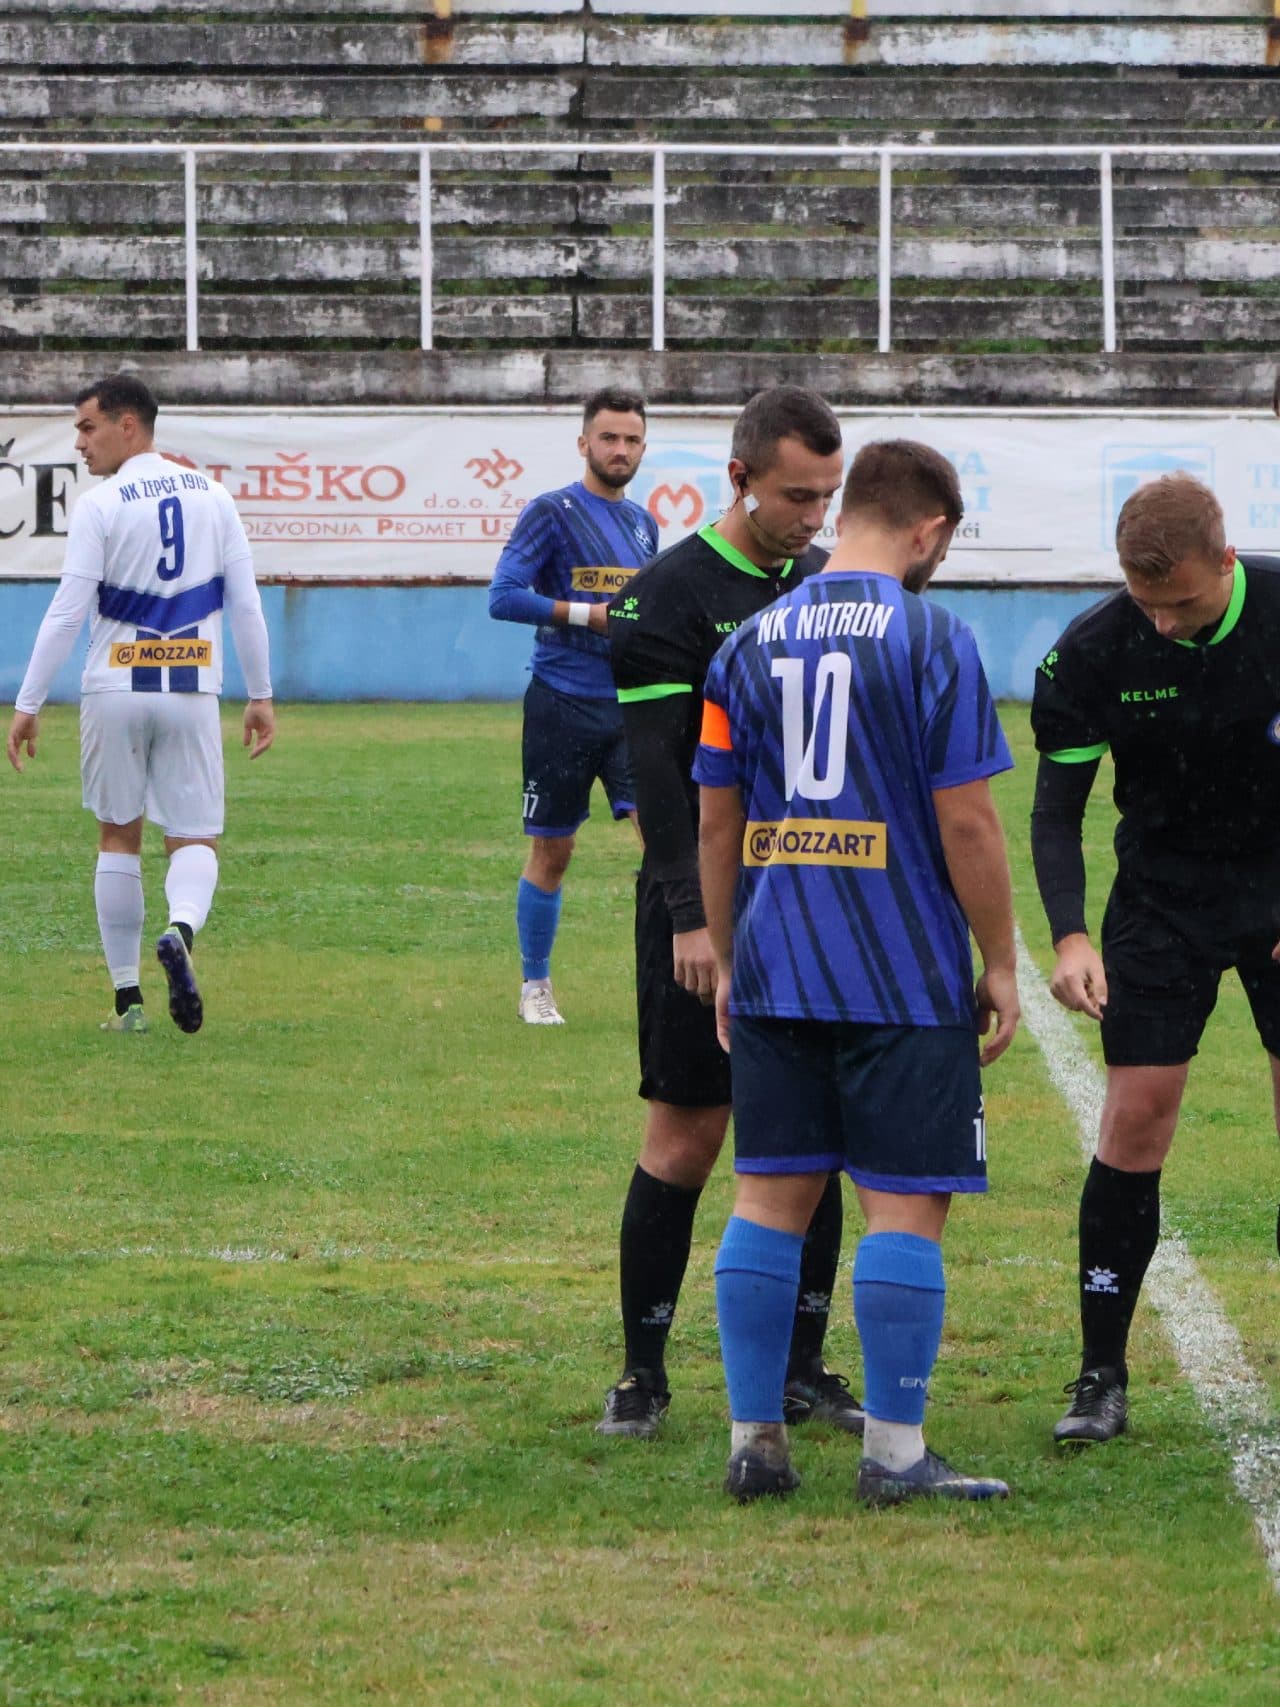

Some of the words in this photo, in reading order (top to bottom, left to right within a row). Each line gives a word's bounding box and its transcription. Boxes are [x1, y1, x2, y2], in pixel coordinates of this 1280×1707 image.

[119, 484, 141, 502] NK
[140, 474, 179, 498] ŽEPČE
[180, 473, 209, 491] 1919
[424, 492, 489, 509] d.o.o.
[156, 495, 186, 582] 9
[377, 518, 466, 536] PROMET
[757, 606, 792, 645] NK
[796, 602, 894, 640] NATRON
[1120, 686, 1179, 703] KELME
[771, 651, 851, 802] 10
[522, 793, 539, 819] 17
[1084, 1283, 1119, 1294] KELME
